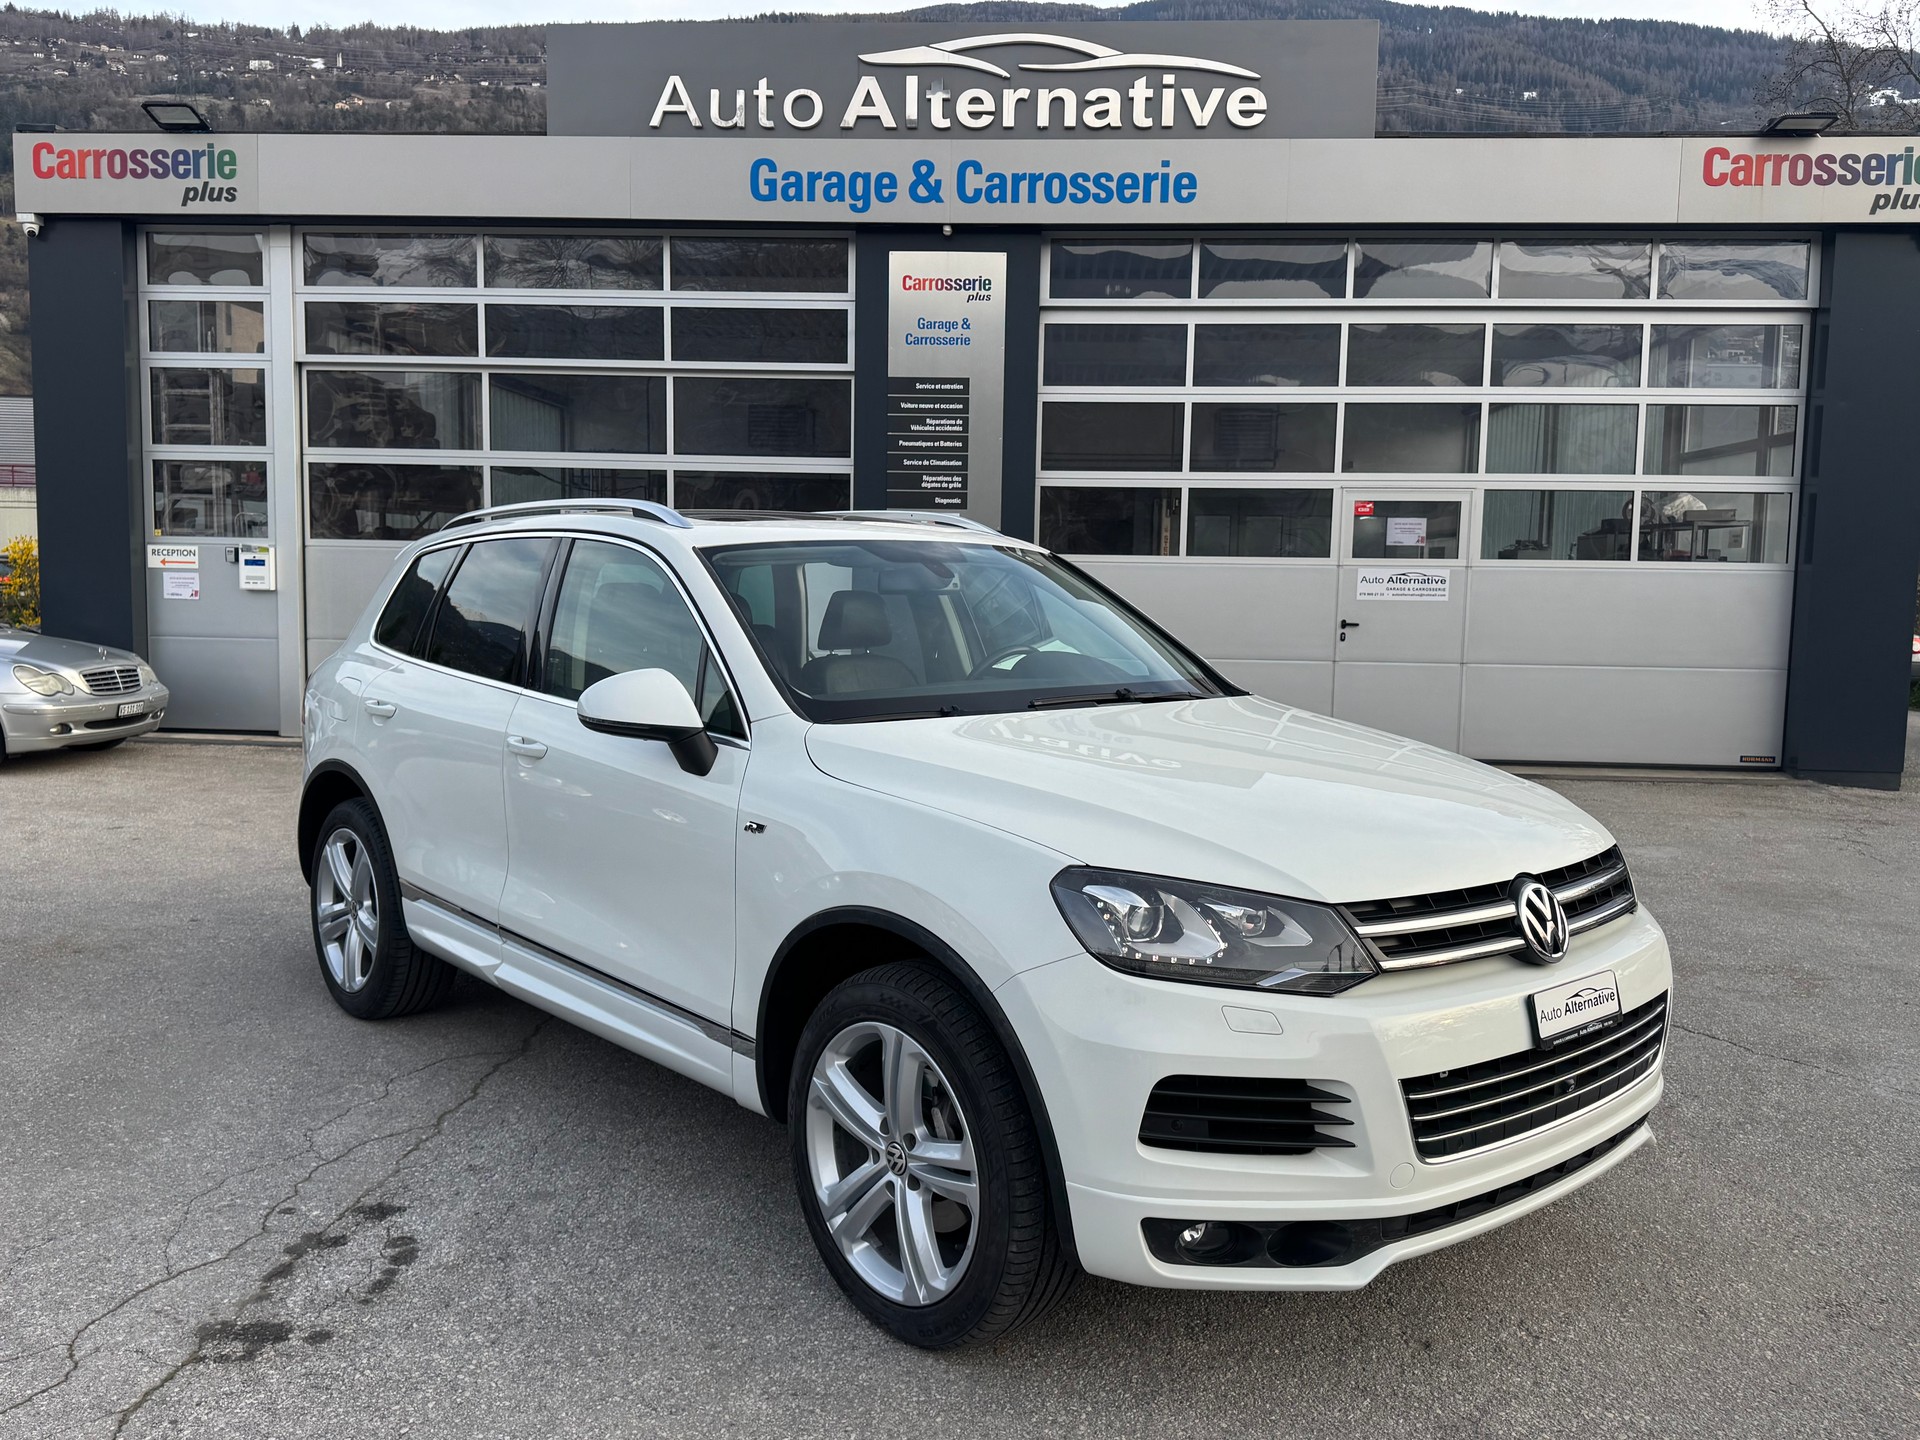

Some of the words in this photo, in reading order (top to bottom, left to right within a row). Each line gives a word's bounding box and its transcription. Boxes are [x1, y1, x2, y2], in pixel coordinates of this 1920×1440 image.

[648, 75, 825, 128] Auto
[839, 73, 1269, 130] Alternative
[32, 142, 237, 180] Carrosserie
[1702, 146, 1920, 187] Carrosseri
[750, 157, 898, 213] Garage
[908, 159, 944, 204] &
[956, 159, 1198, 204] Carrosserie
[181, 181, 238, 207] plus
[1869, 188, 1920, 215] plu
[902, 274, 992, 292] Carrosserie
[967, 291, 992, 303] plus
[917, 317, 959, 332] Garage
[961, 317, 971, 330] &
[905, 333, 971, 346] Carrosserie
[915, 382, 935, 390] Service
[899, 440, 934, 448] Pneumatiques
[940, 440, 963, 448] Batteries
[934, 496, 962, 505] Diagnostic
[151, 549, 197, 557] RECEPTION
[1360, 576, 1385, 584] Auto
[1387, 576, 1447, 585] Alternative
[1540, 1007, 1562, 1023] Auto
[1564, 990, 1616, 1016] Alternative
